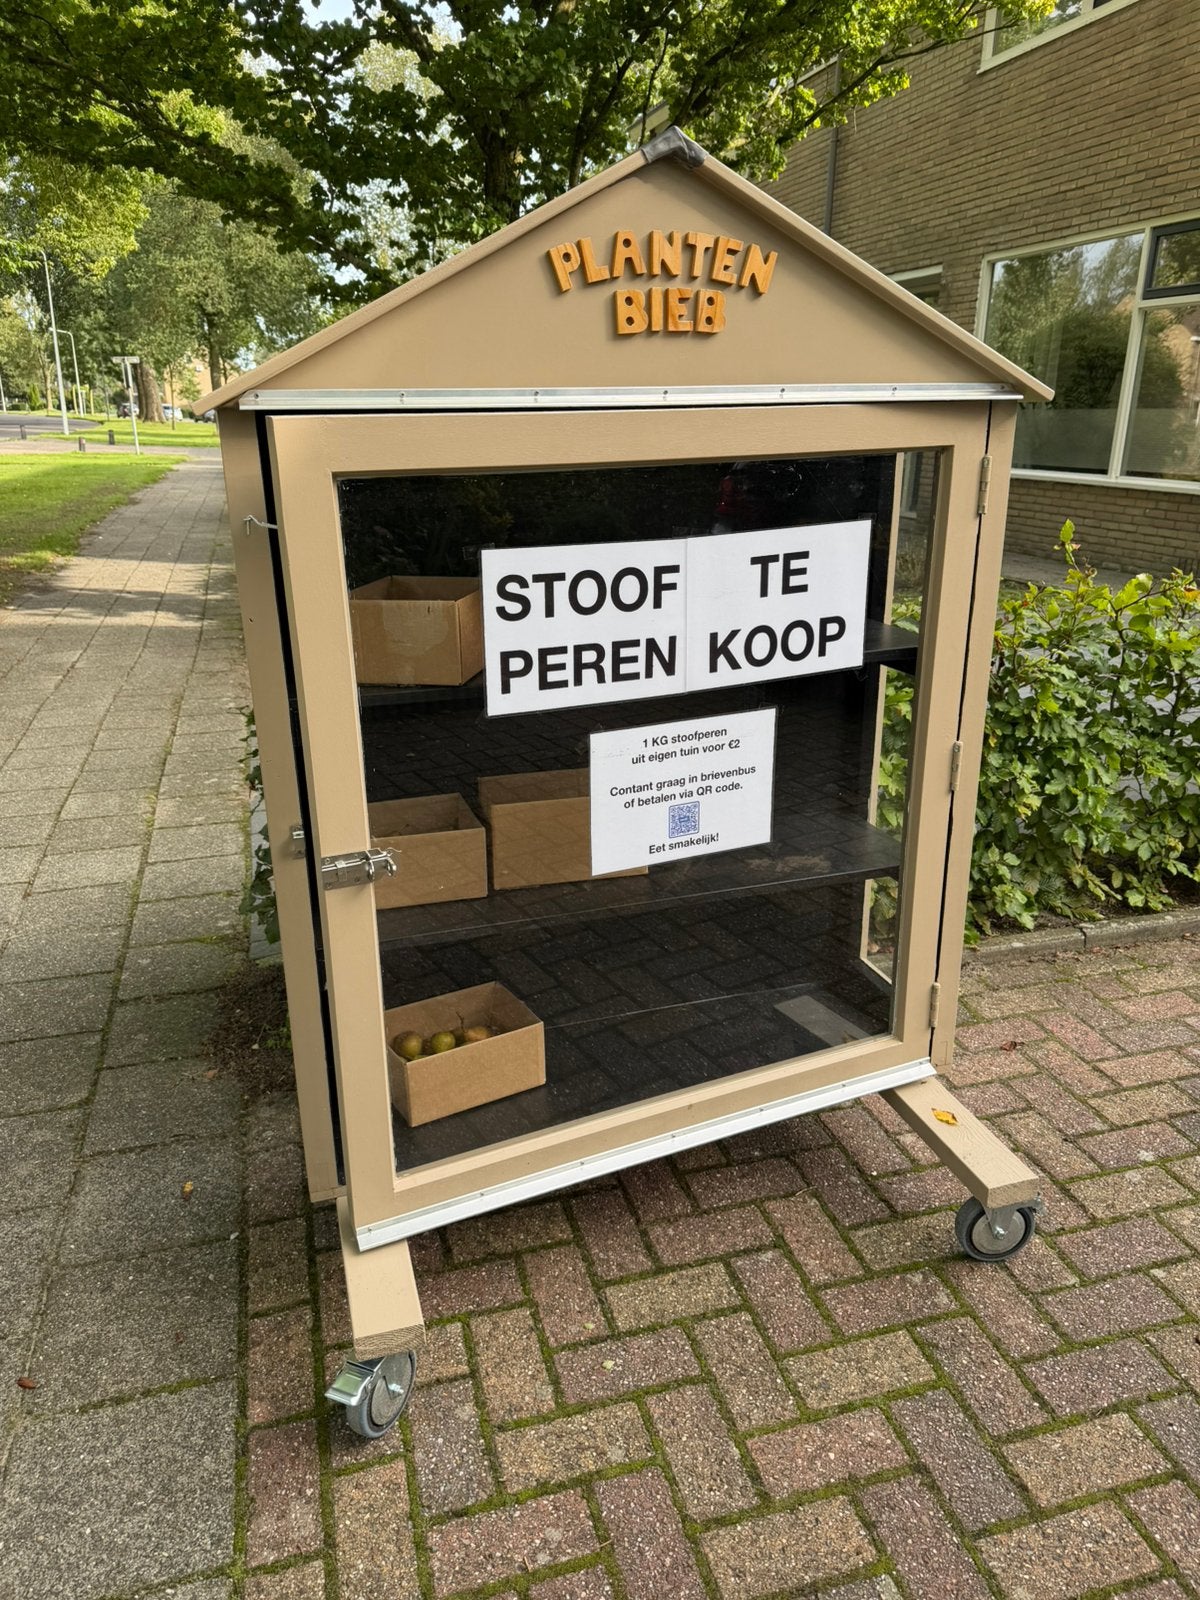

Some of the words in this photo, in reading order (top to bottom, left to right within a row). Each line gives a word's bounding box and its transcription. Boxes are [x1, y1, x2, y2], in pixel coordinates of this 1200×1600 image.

[547, 230, 778, 294] PLANTEN
[615, 287, 727, 334] BIEB
[495, 564, 680, 622] STOOF
[750, 550, 810, 598] TE
[499, 635, 677, 695] PEREN
[708, 615, 847, 673] KOOP
[631, 754, 645, 764] uit
[648, 751, 677, 763] eigen
[680, 746, 699, 757] tuin
[702, 743, 725, 753] voor
[728, 739, 741, 749] €2
[642, 739, 648, 748] 1
[651, 735, 669, 746] KG
[671, 728, 727, 744] stoofperen
[610, 782, 653, 797] Contant
[656, 777, 686, 791] graag
[688, 774, 698, 784] in
[700, 765, 756, 782] brievenbus
[624, 798, 635, 809] of
[637, 793, 676, 807] betalen
[679, 788, 694, 799] via
[696, 785, 712, 796] QR
[715, 781, 743, 793] code.
[649, 844, 666, 854] Eet
[668, 832, 719, 850] smakelijk!
